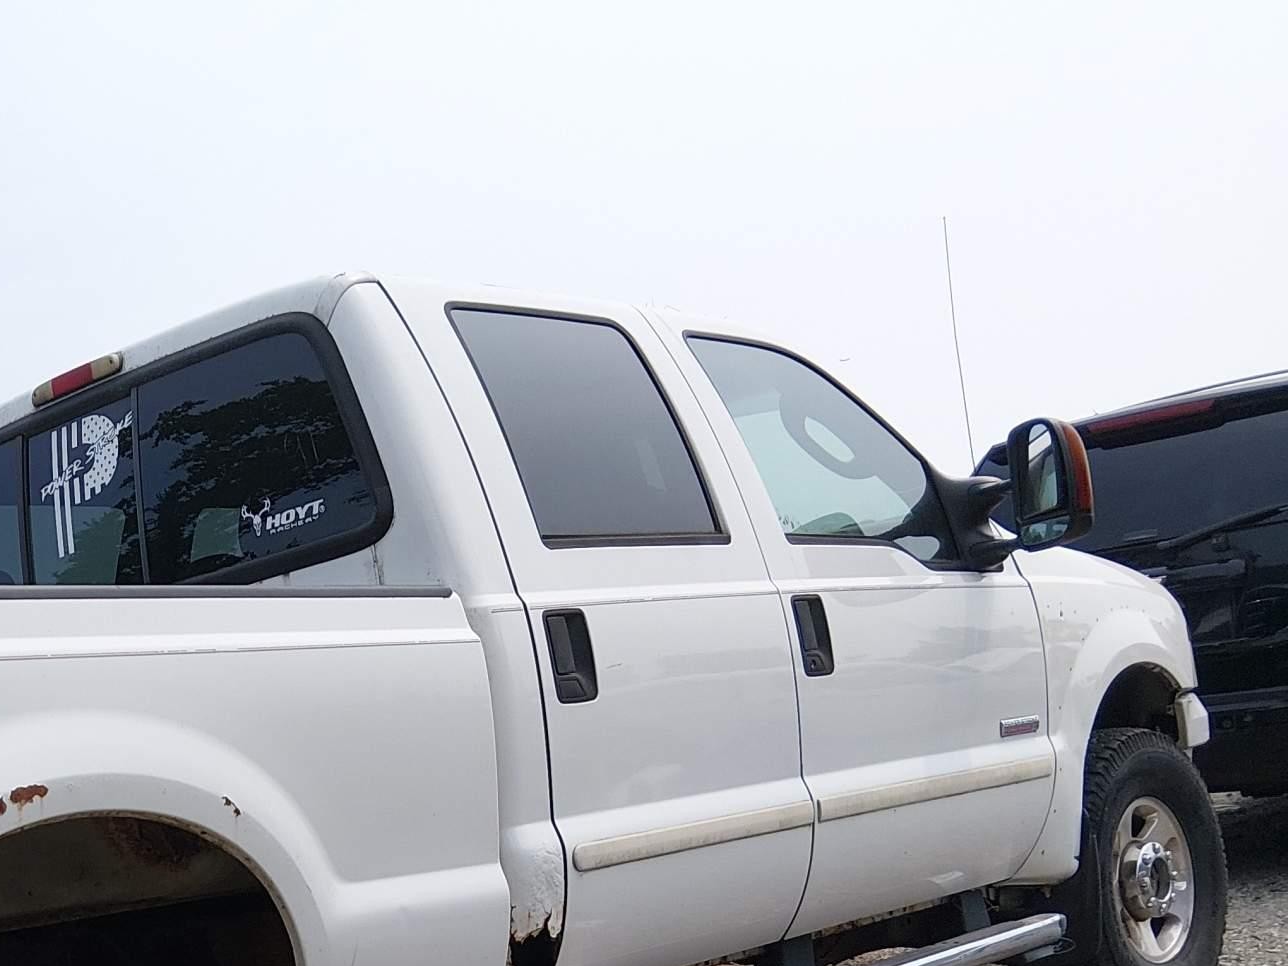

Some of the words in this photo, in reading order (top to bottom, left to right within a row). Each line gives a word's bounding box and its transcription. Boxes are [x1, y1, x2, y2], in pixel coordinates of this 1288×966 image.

[41, 459, 85, 503] POWER
[85, 410, 133, 465] STROKE
[266, 499, 324, 530] HOYT
